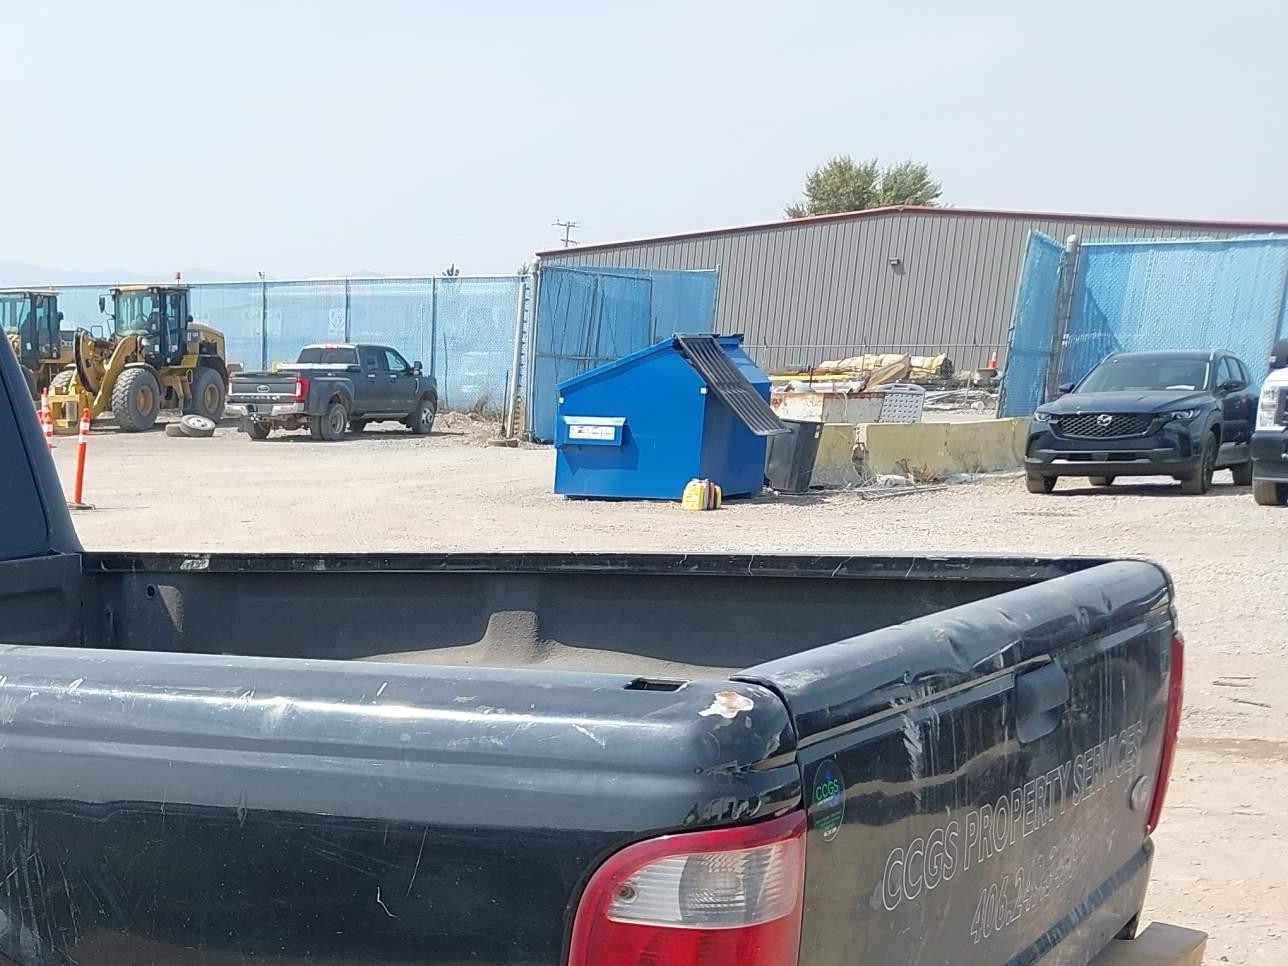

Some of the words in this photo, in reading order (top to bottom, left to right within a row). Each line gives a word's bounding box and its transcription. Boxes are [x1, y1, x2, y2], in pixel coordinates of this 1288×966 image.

[815, 778, 840, 801] CCGS
[882, 821, 959, 911] CCGS
[963, 760, 1072, 871] PROPERTY
[1072, 720, 1144, 806] SERVICES
